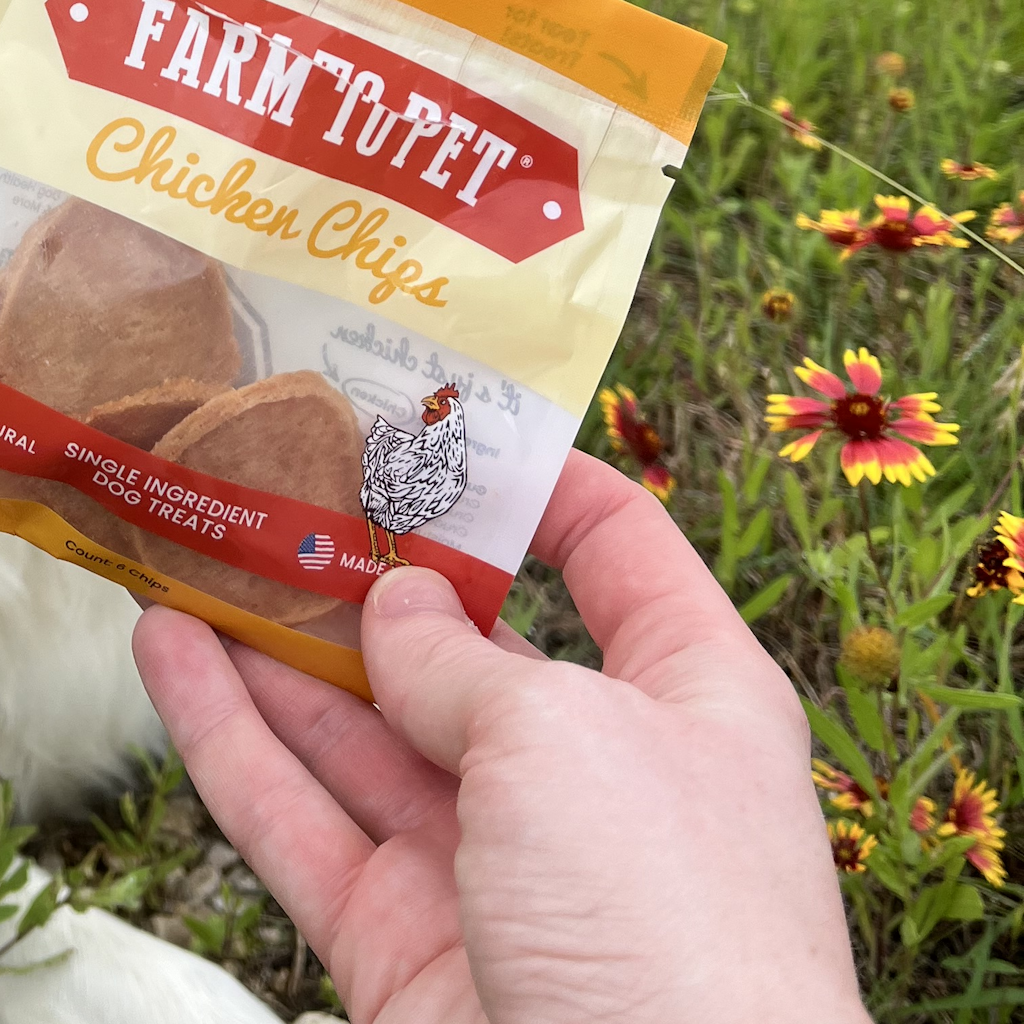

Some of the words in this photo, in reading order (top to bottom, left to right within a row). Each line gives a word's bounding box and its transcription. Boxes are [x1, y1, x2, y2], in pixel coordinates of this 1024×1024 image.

[314, 48, 392, 159] TO
[85, 116, 302, 240] Chicken
[306, 199, 448, 308] Chips
[64, 442, 141, 486] SINGLE
[144, 475, 268, 530] INGREDIENT
[92, 470, 142, 505] DOG
[147, 497, 228, 541] TREATS
[65, 540, 113, 566] Count
[129, 568, 169, 593] Chips
[339, 552, 387, 576] MADE
